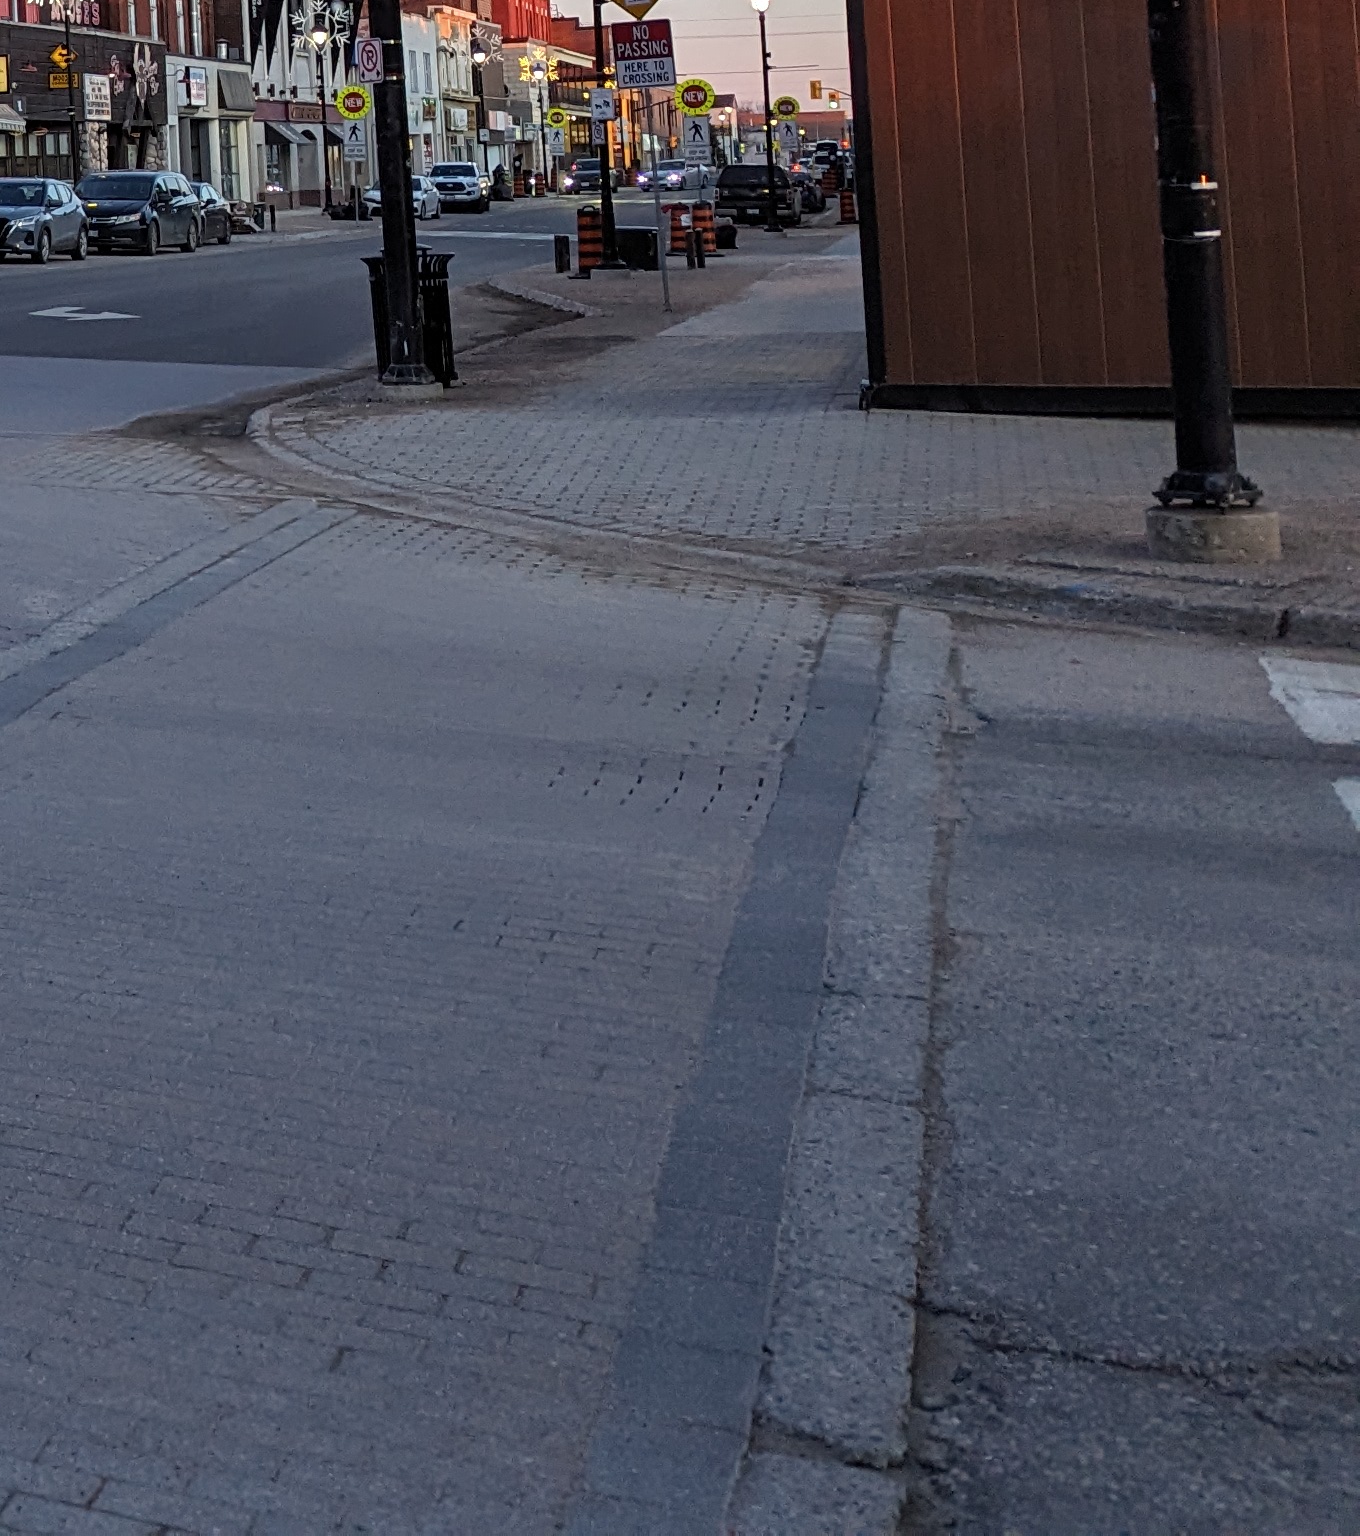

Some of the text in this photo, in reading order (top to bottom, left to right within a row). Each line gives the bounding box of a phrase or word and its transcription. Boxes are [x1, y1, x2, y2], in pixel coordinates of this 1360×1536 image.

[632, 24, 649, 41] NO
[616, 39, 670, 58] PASSING
[624, 60, 665, 73] HERE TO
[622, 72, 670, 85] CROSSING
[344, 97, 364, 108] NEW
[682, 91, 705, 103] NEW
